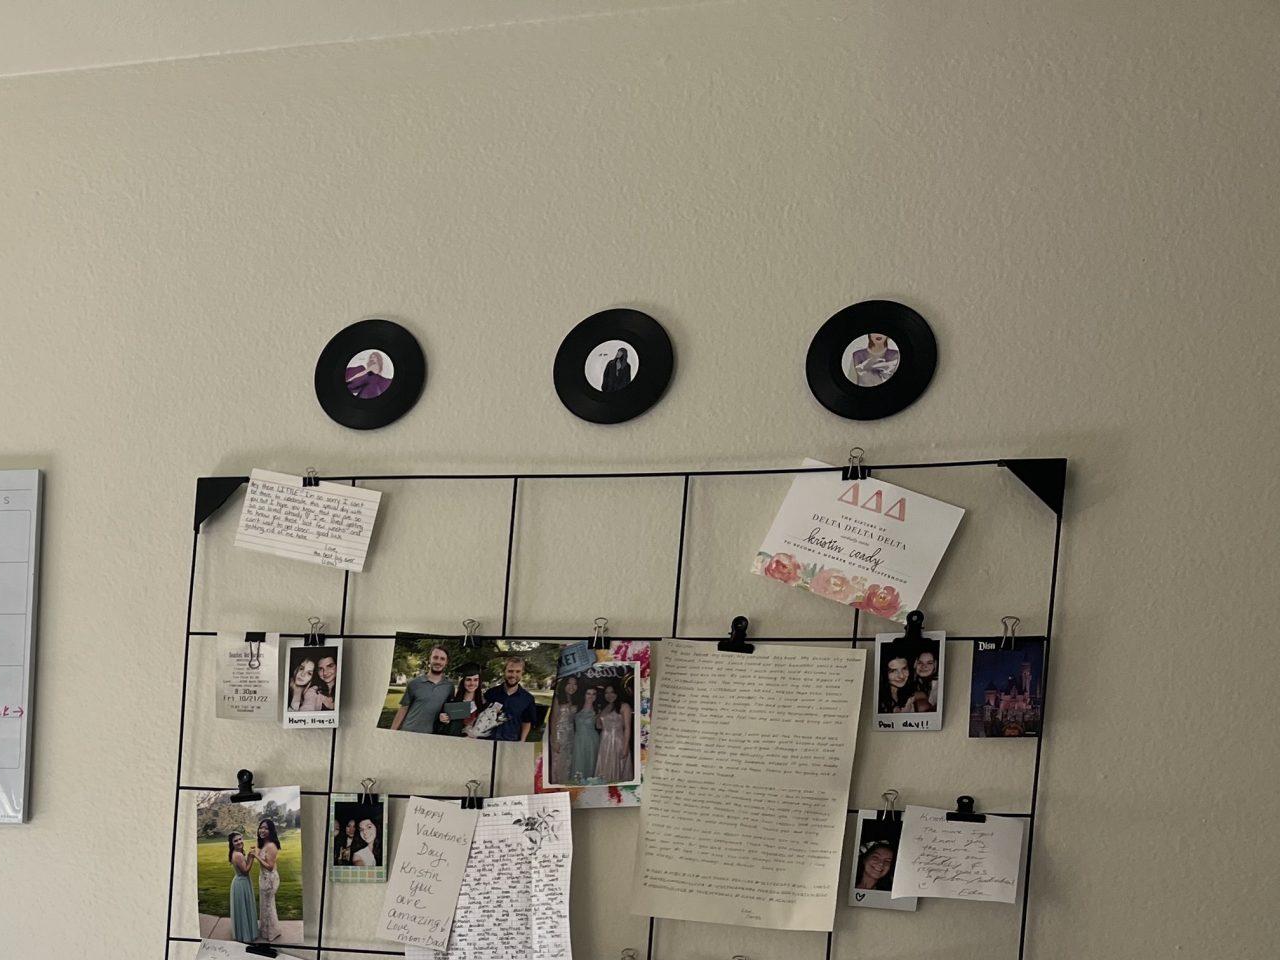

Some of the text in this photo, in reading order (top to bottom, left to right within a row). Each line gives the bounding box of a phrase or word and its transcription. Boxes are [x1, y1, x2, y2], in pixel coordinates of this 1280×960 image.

[3, 496, 10, 504] S
[812, 513, 841, 529] DELTA
[844, 524, 874, 540] DELTA
[877, 535, 907, 551] DELTA
[978, 640, 996, 651] Disn
[878, 719, 895, 729] Pool
[414, 804, 444, 823] Happy
[416, 823, 468, 846] Valentine's
[400, 861, 442, 882] Kristin
[396, 894, 426, 909] are
[388, 908, 450, 933] amazing!
